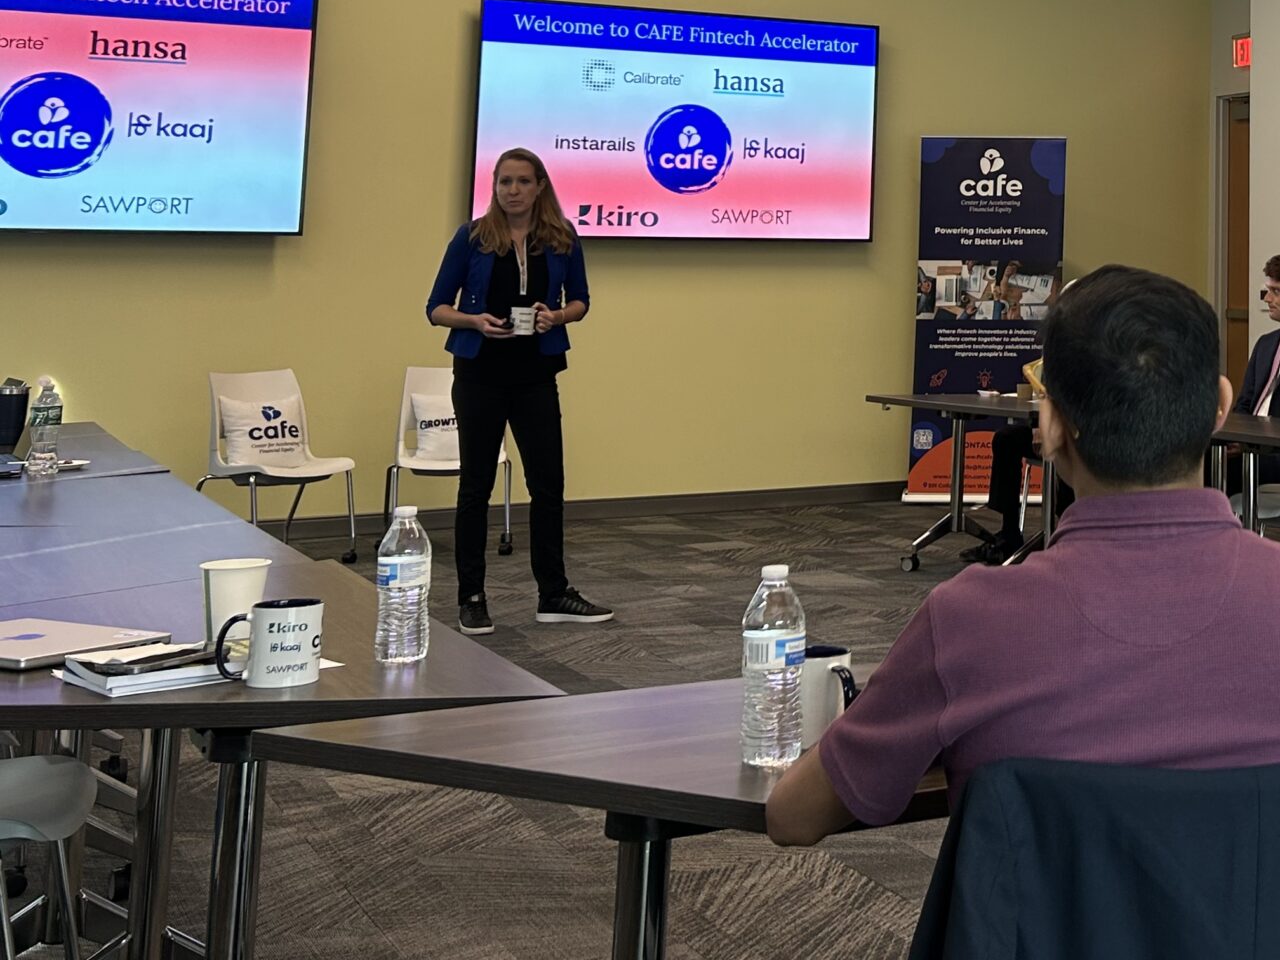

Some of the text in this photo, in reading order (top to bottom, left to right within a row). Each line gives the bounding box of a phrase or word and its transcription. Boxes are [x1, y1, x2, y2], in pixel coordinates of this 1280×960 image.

[513, 14, 859, 54] Welcome to CAFE Fintech Accelerator
[89, 30, 187, 61] hansa
[623, 71, 682, 86] Calibrate
[713, 68, 785, 94] hansa
[11, 125, 92, 150] cafe
[156, 112, 214, 144] kaaj
[554, 135, 636, 152] instarails
[764, 138, 806, 164] kaaj
[659, 149, 718, 171] cafe
[959, 174, 1023, 197] cafe
[80, 195, 193, 215] SAWPORT
[596, 205, 659, 228] kiro
[711, 208, 793, 225] SAWPORT
[934, 226, 1049, 236] Powering Inclusive Finance,
[960, 237, 973, 245] for
[1002, 238, 1024, 246] Lives
[248, 420, 299, 441] cafe
[420, 417, 457, 430] GROWT
[277, 623, 309, 634] kiro
[280, 641, 302, 652] kaaj
[265, 662, 309, 674] SAWPORT
